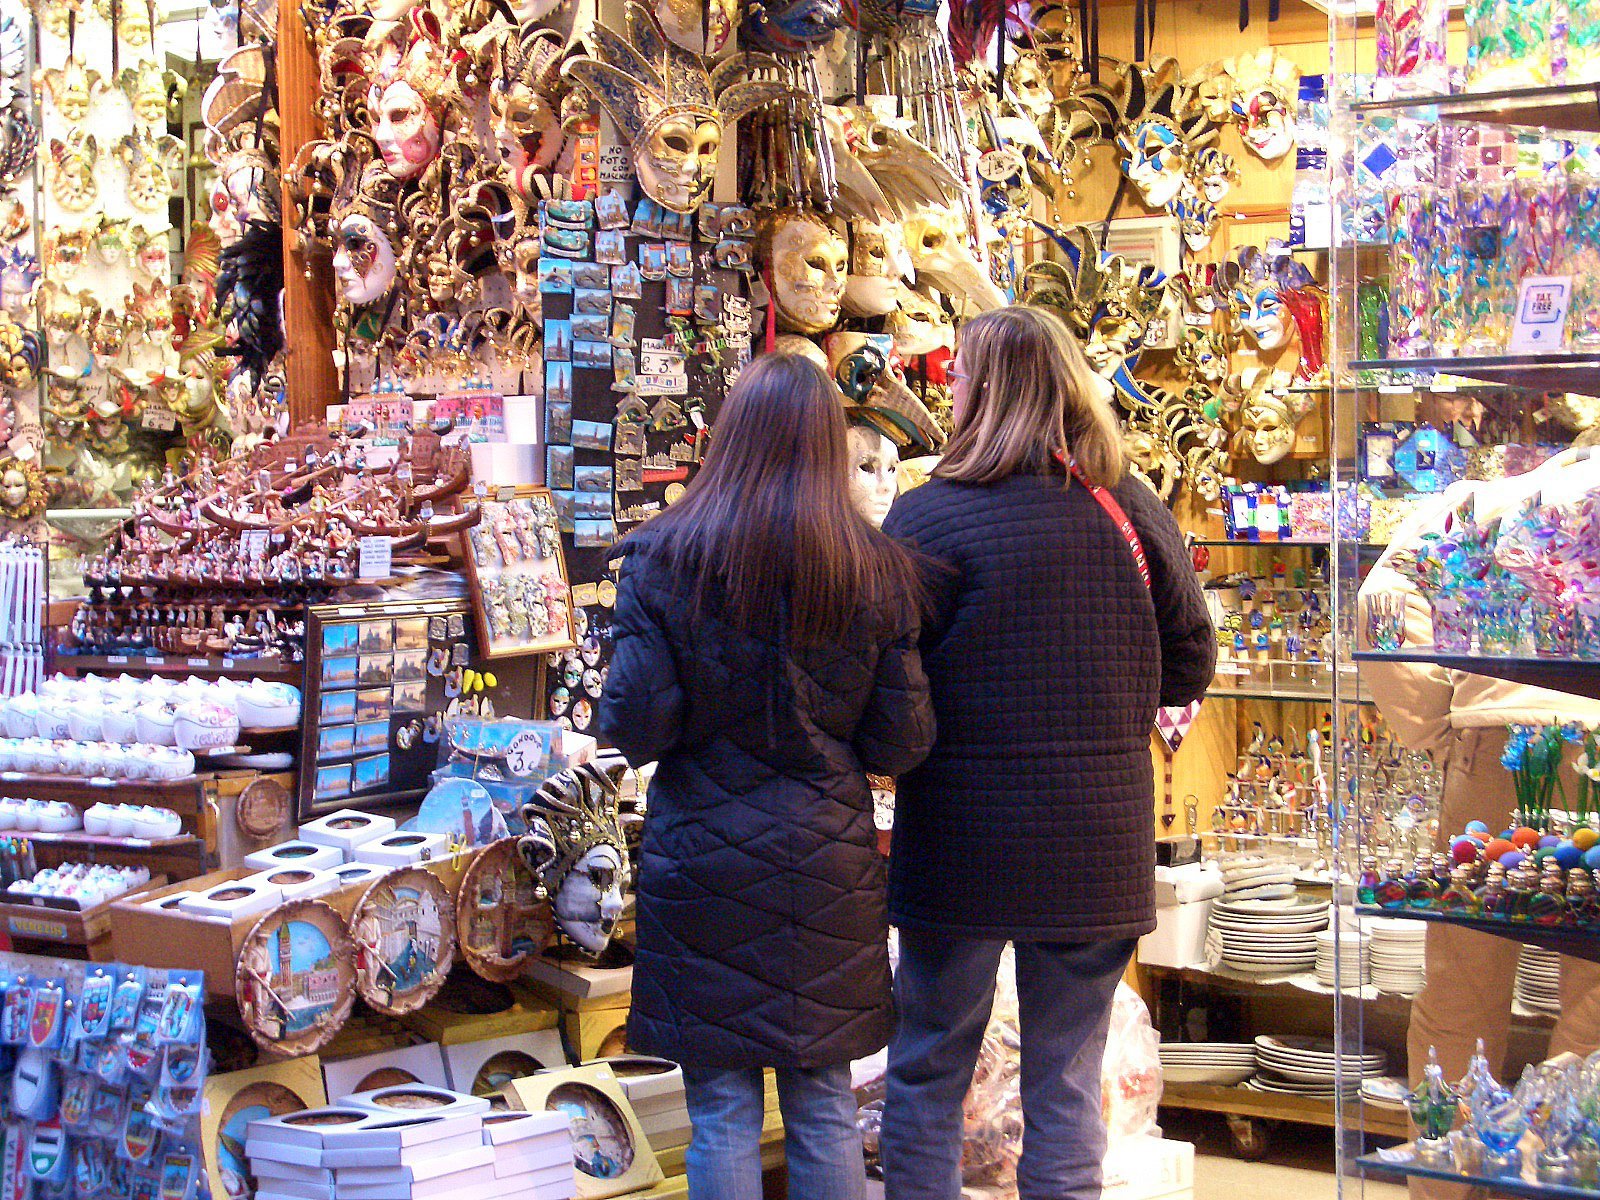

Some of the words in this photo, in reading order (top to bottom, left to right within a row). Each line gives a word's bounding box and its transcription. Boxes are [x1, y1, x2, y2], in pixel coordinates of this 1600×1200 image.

[609, 146, 622, 154] NO
[600, 155, 628, 164] FOTO
[1532, 302, 1552, 310] FREE
